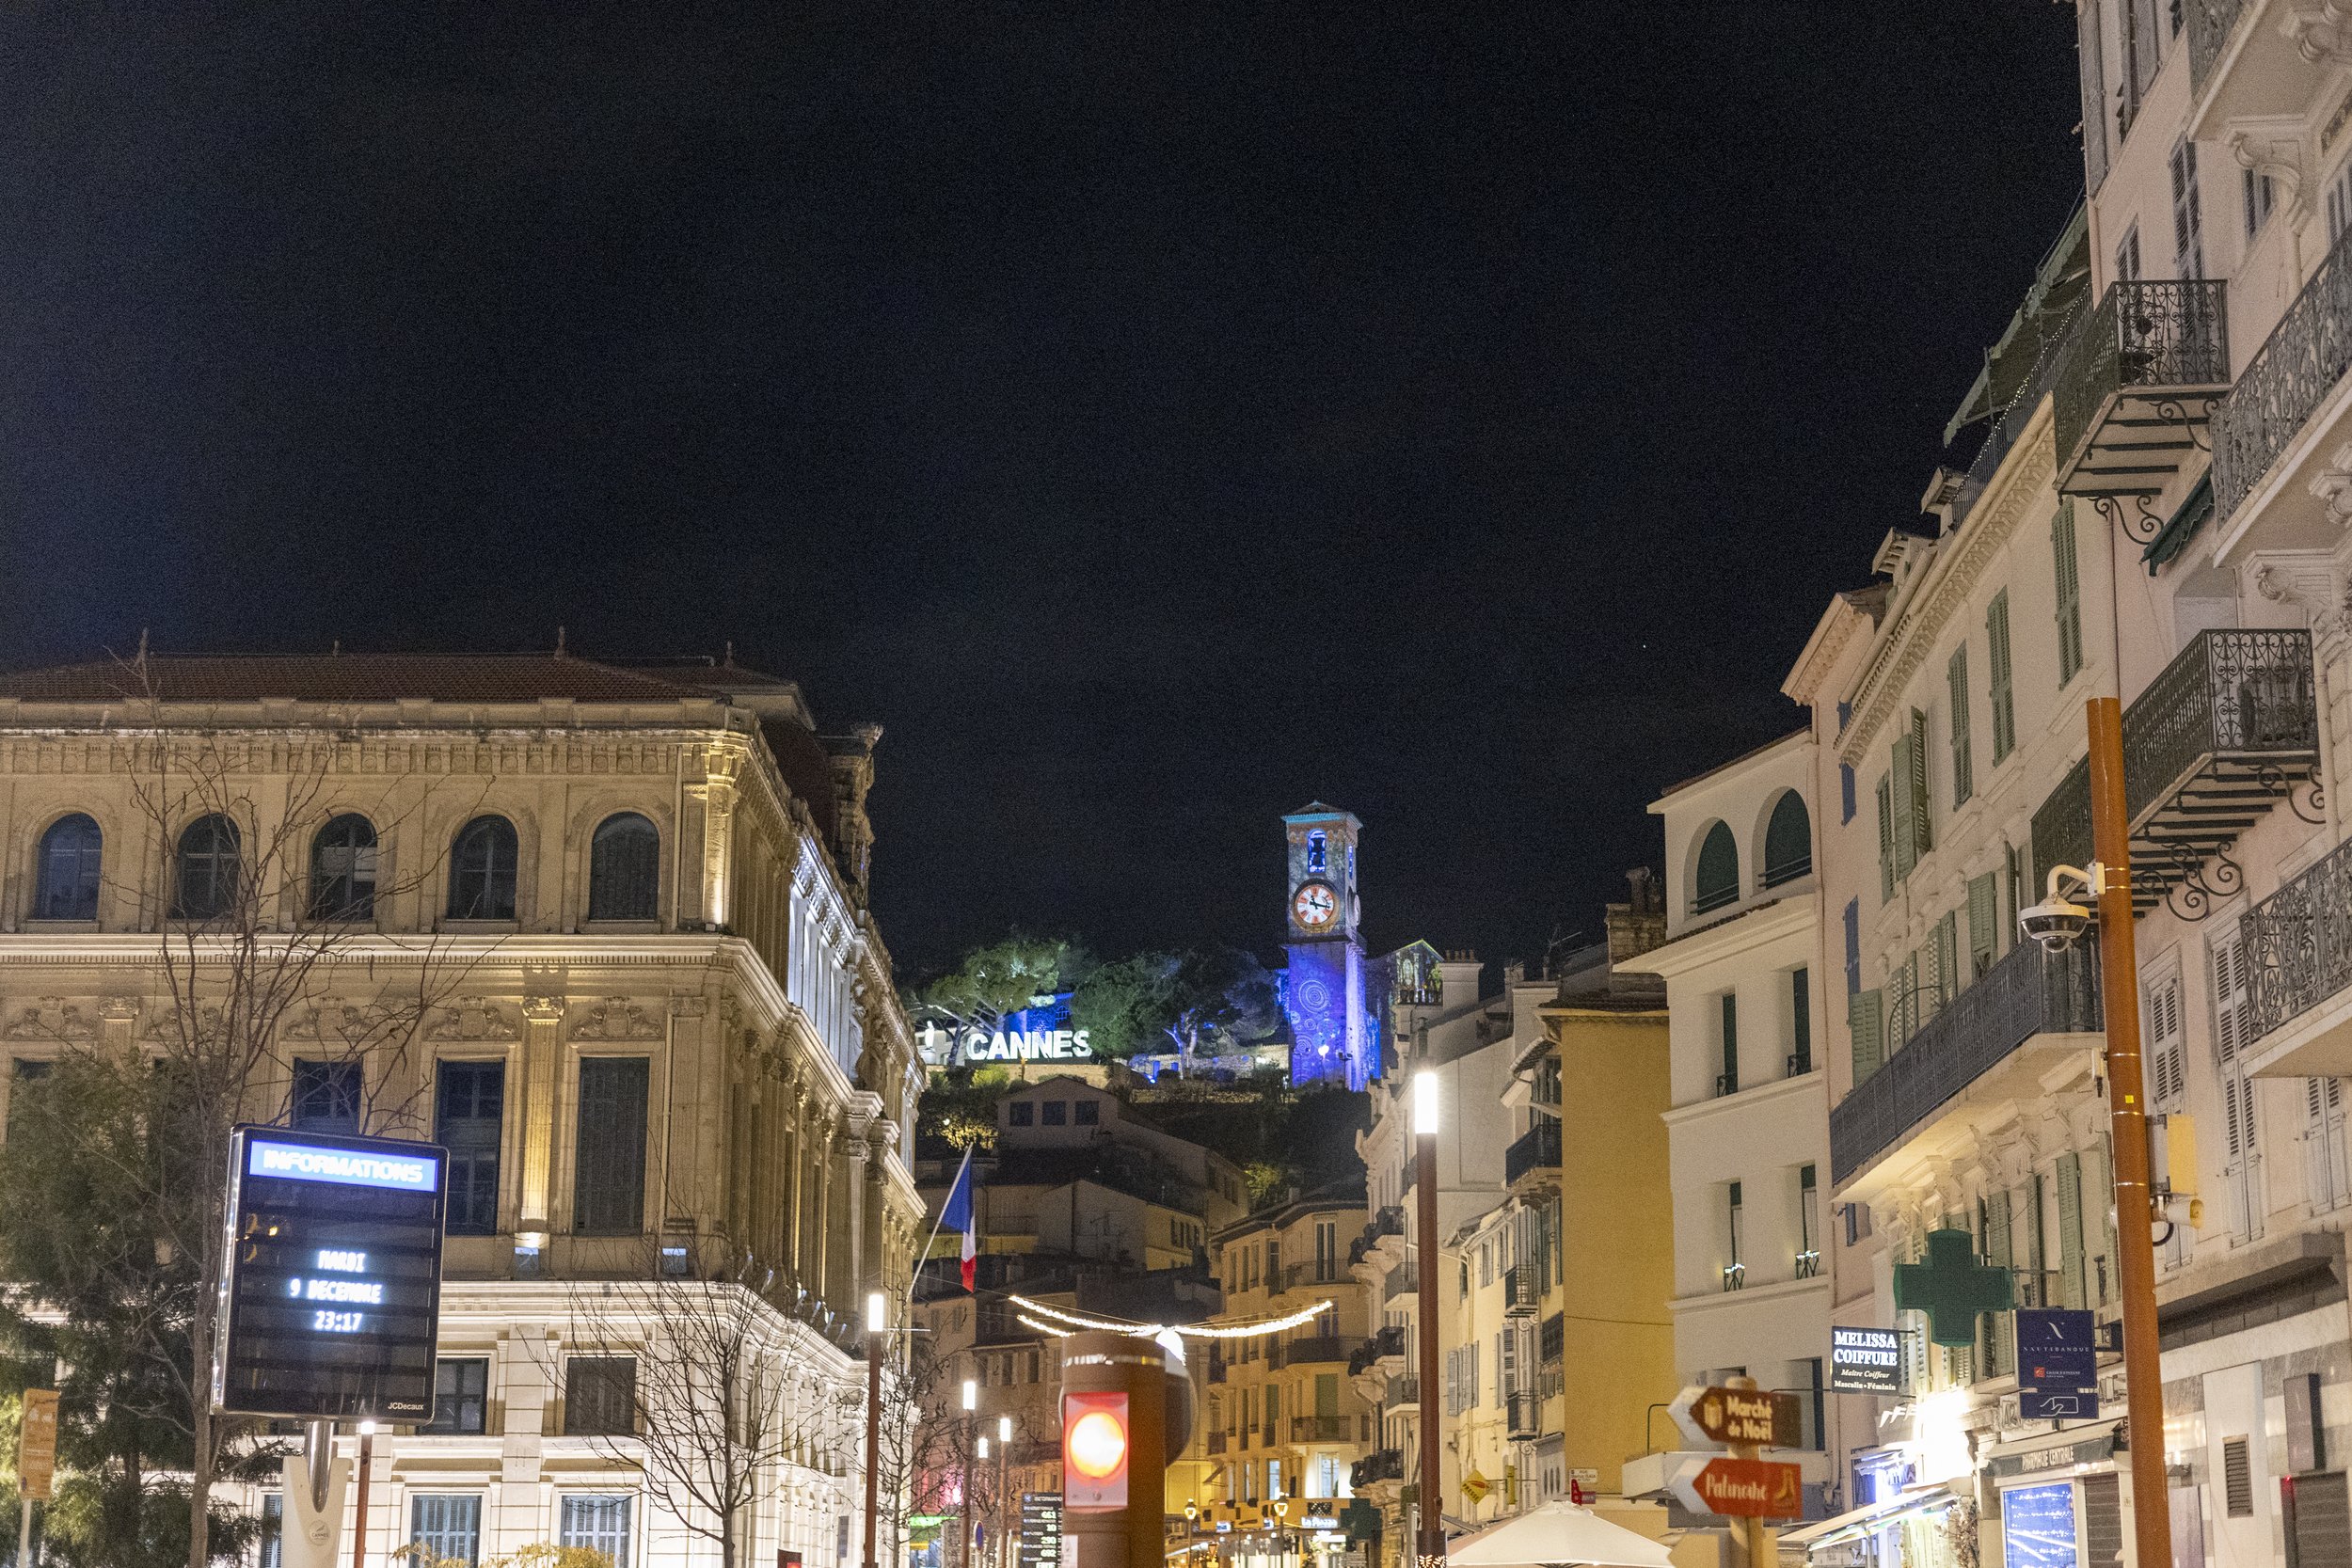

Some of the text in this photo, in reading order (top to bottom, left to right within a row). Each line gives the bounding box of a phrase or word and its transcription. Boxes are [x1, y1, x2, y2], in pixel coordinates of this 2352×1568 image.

[966, 1030, 1092, 1060] CANNES
[262, 1149, 423, 1182] INFORMATIONS
[318, 1250, 365, 1273] MARDI
[290, 1278, 382, 1304] 9 DECEMBRE
[314, 1310, 363, 1331] 23:17
[1834, 1331, 1898, 1348] MELISSA
[1834, 1349, 1898, 1366] COIFFURE
[1864, 1370, 1890, 1379] Coiffeur
[388, 1402, 424, 1410] JCDecaux
[1726, 1395, 1773, 1419] Marché
[1727, 1418, 1772, 1441] de Noël
[2049, 1445, 2074, 1466] CENTRALE
